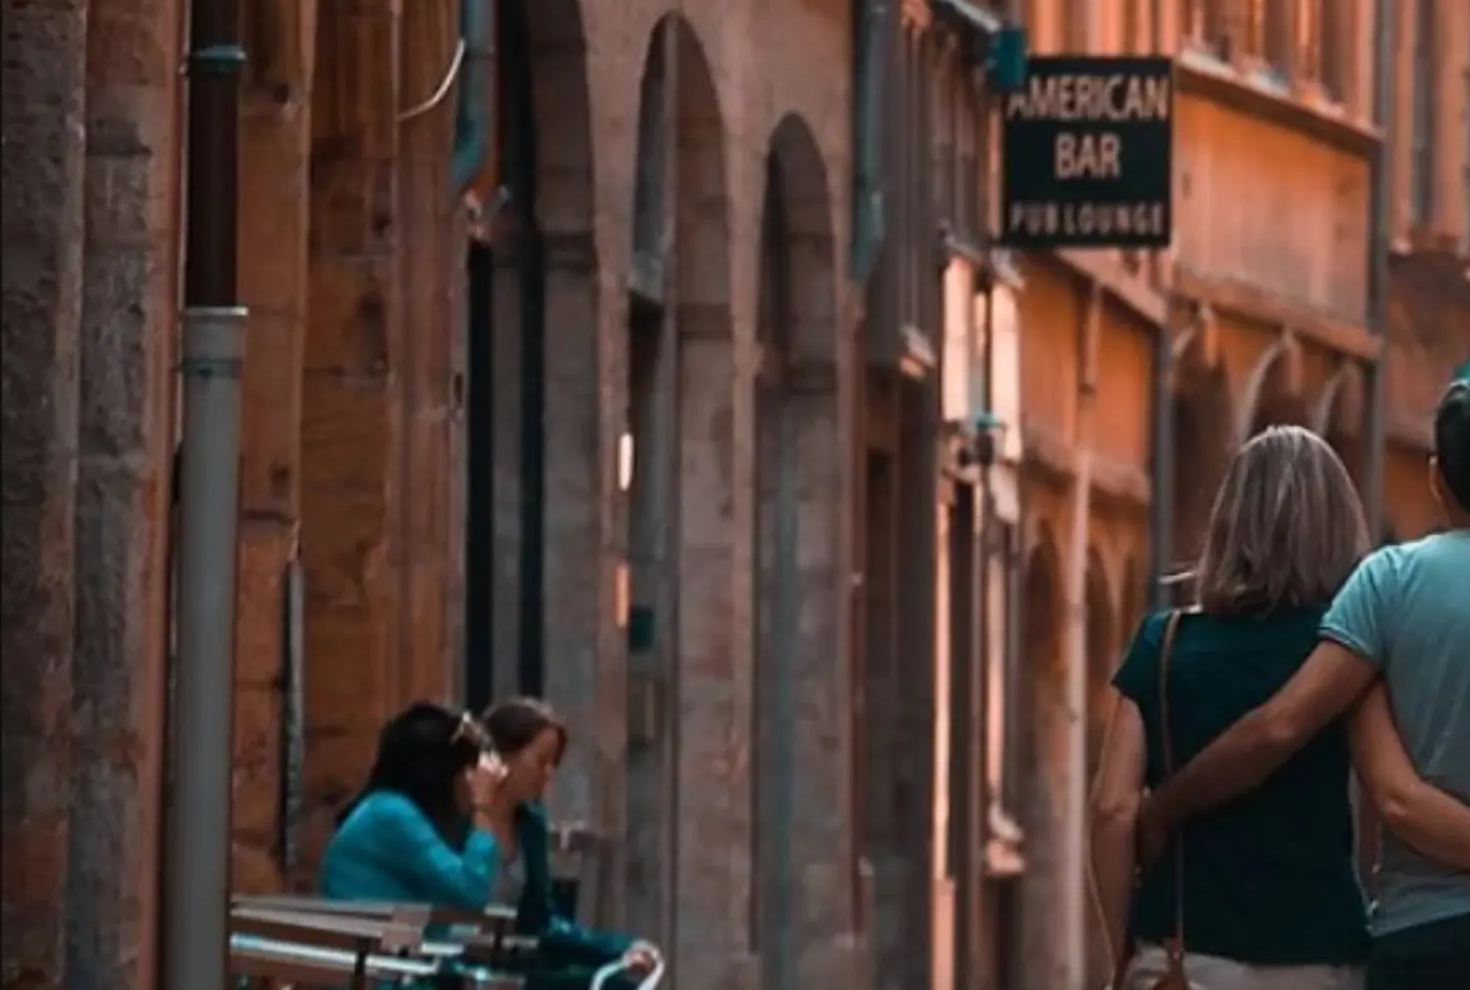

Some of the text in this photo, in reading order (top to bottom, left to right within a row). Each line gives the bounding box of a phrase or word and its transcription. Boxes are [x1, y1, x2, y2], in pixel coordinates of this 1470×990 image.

[1006, 74, 1168, 121] AMERICAN
[1055, 132, 1121, 180] BAR
[1010, 201, 1164, 236] PUB LOUNGE
